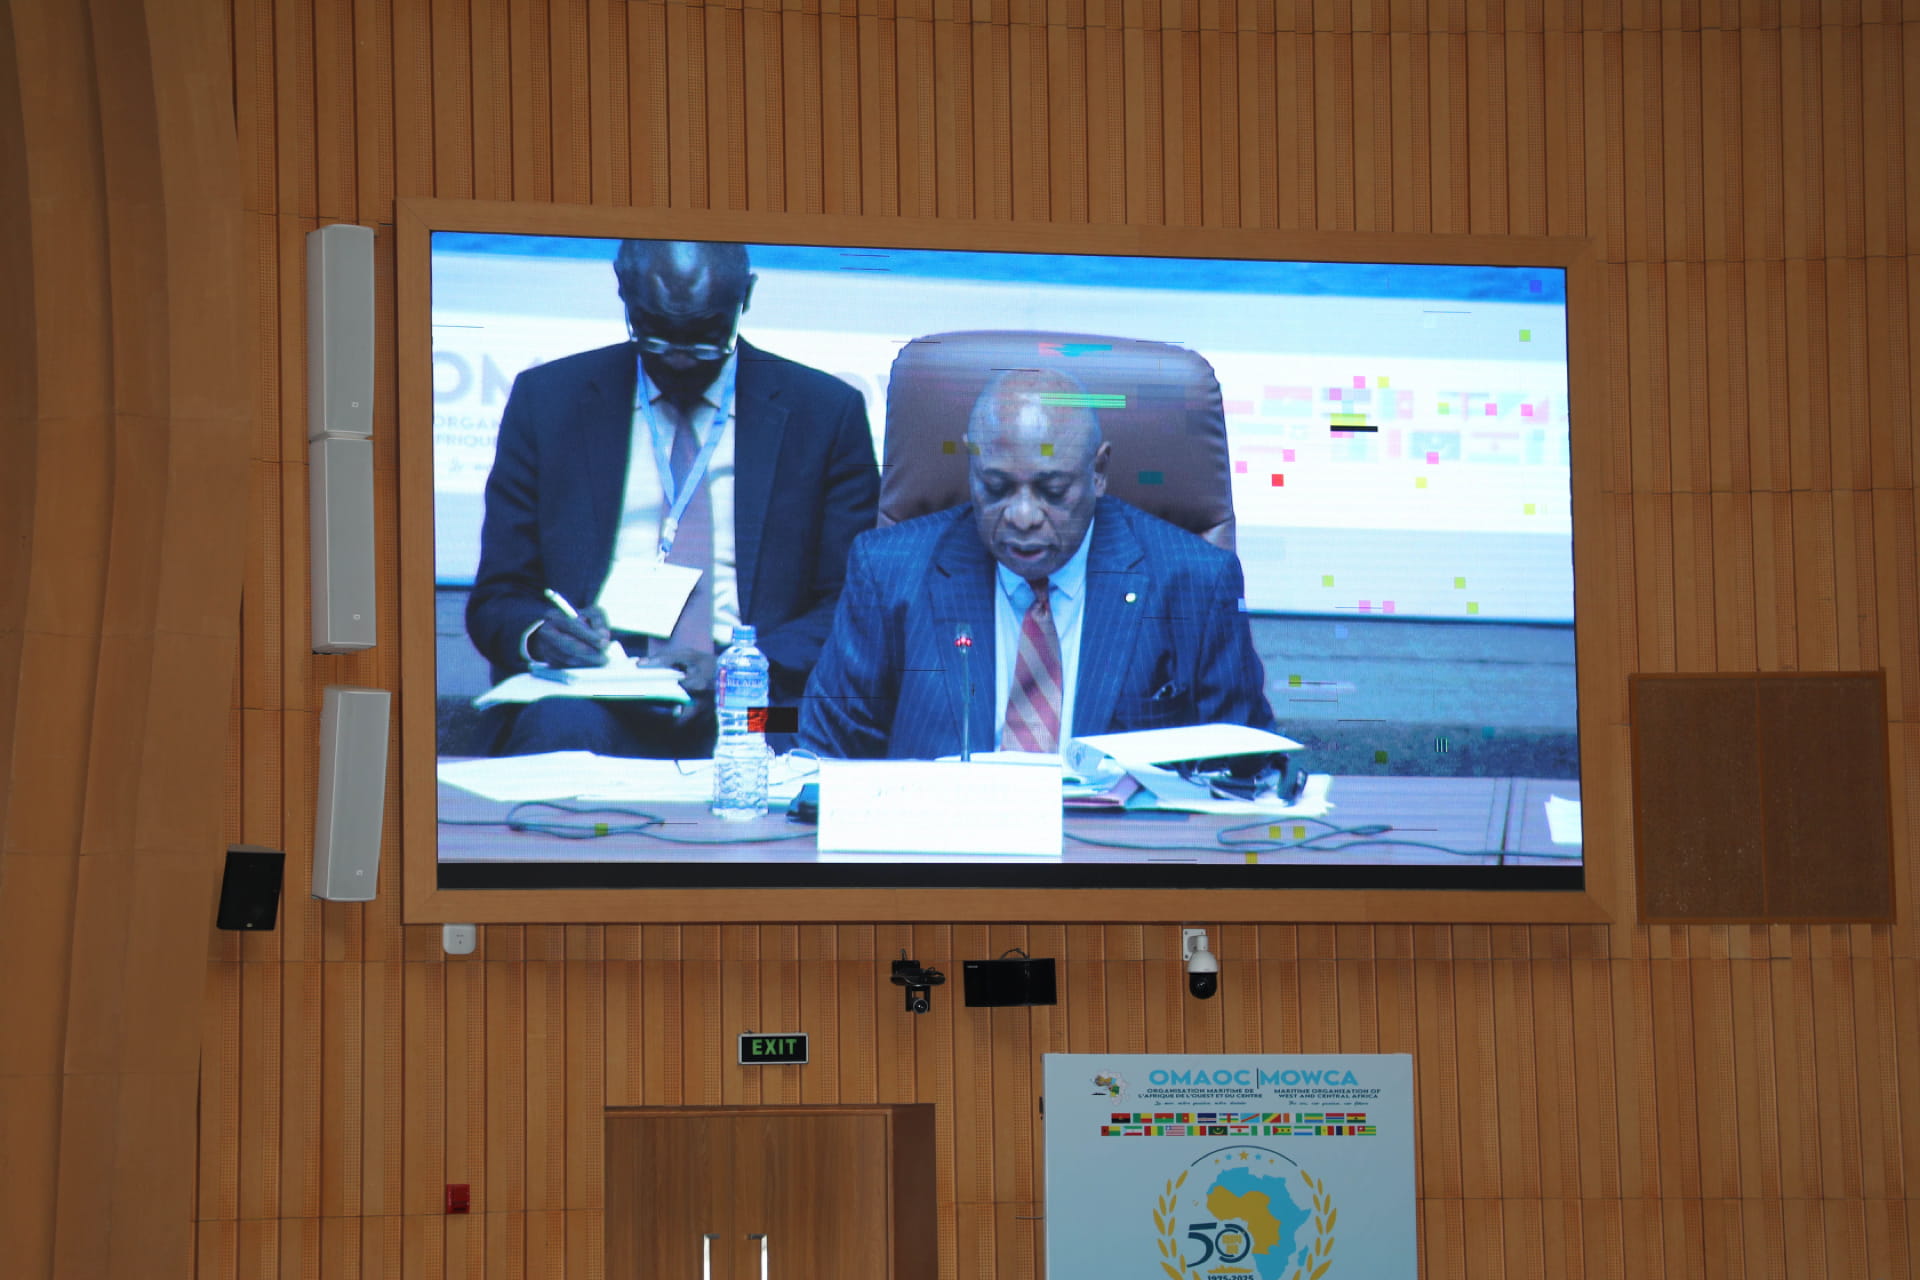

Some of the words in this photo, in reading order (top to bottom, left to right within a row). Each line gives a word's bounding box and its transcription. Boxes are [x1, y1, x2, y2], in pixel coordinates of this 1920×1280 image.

[752, 1039, 797, 1055] EXIT
[1149, 1069, 1251, 1086] OMAOC
[1259, 1069, 1359, 1086] MOWCA
[1186, 1222, 1251, 1268] 50
